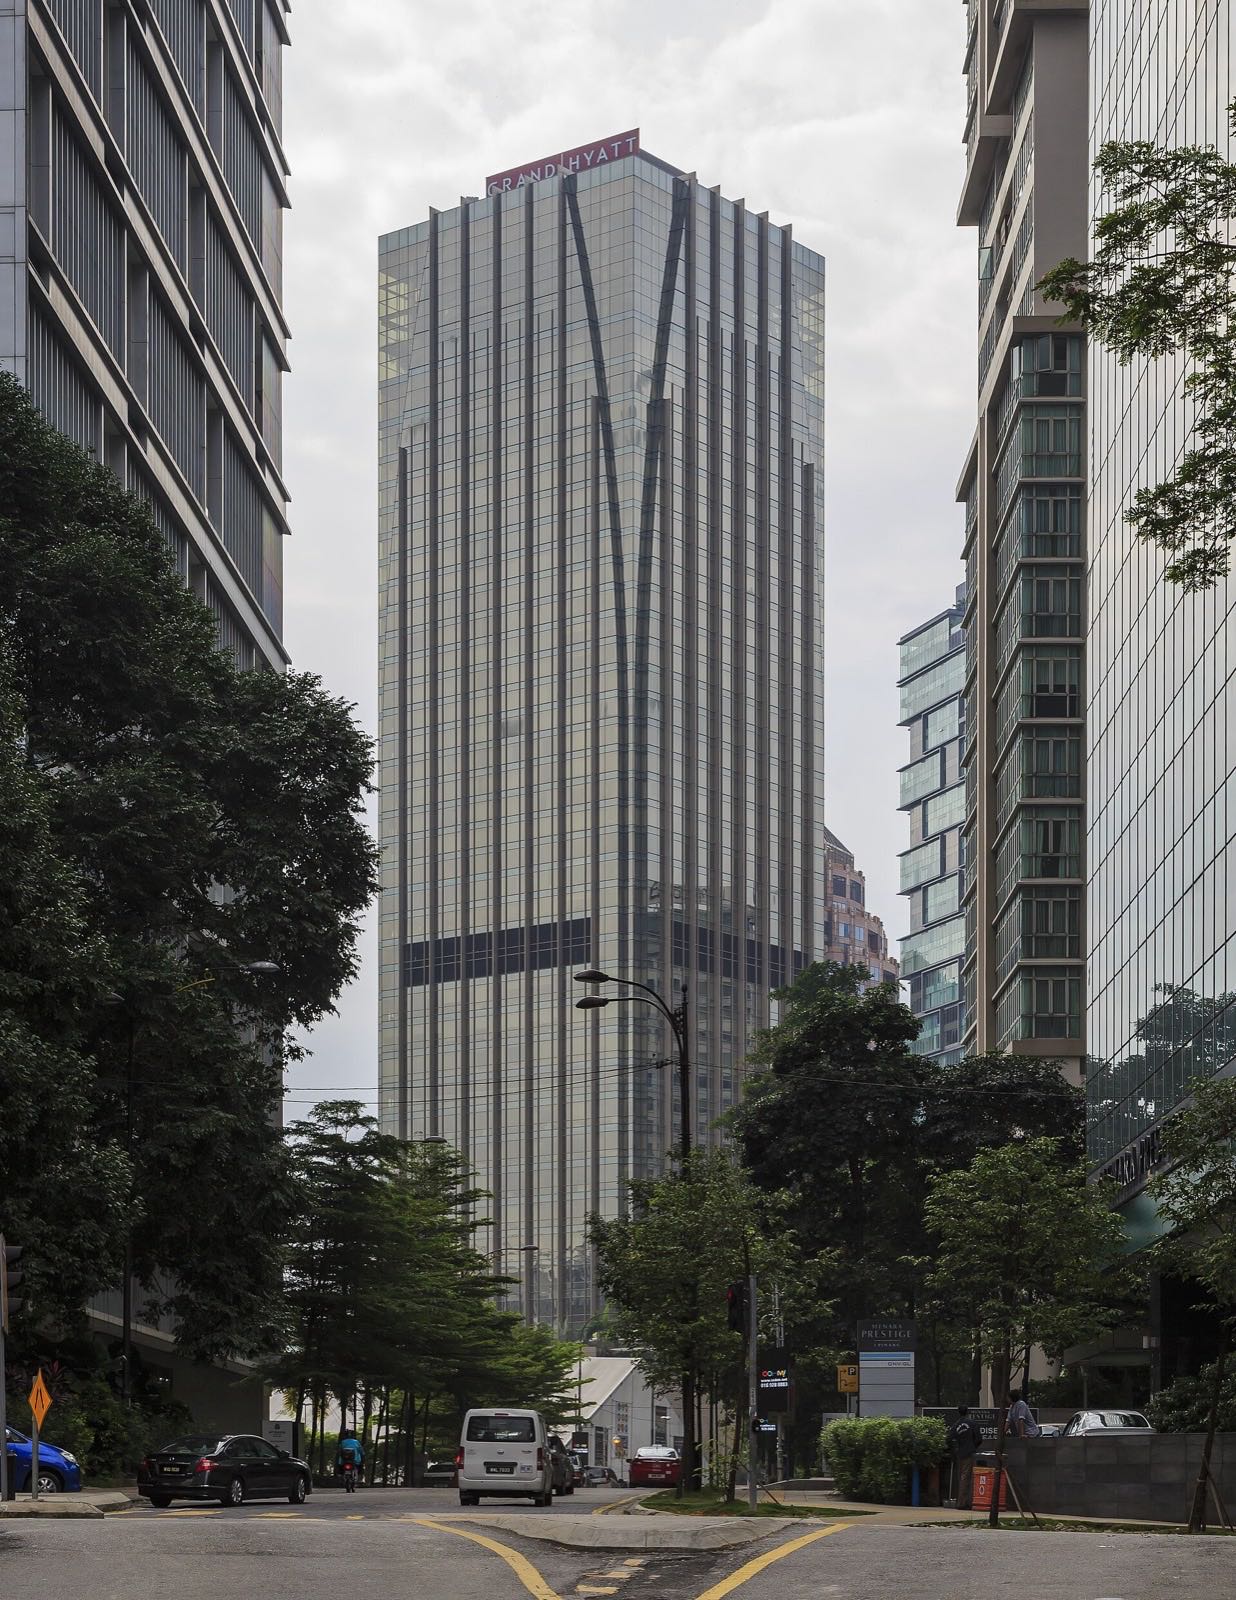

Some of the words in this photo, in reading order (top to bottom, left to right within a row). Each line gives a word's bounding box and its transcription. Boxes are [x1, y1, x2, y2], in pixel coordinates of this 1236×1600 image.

[487, 164, 555, 197] GRAND
[569, 136, 637, 171] HYATT
[861, 1330, 912, 1338] PRESTIGE
[849, 1367, 855, 1375] P
